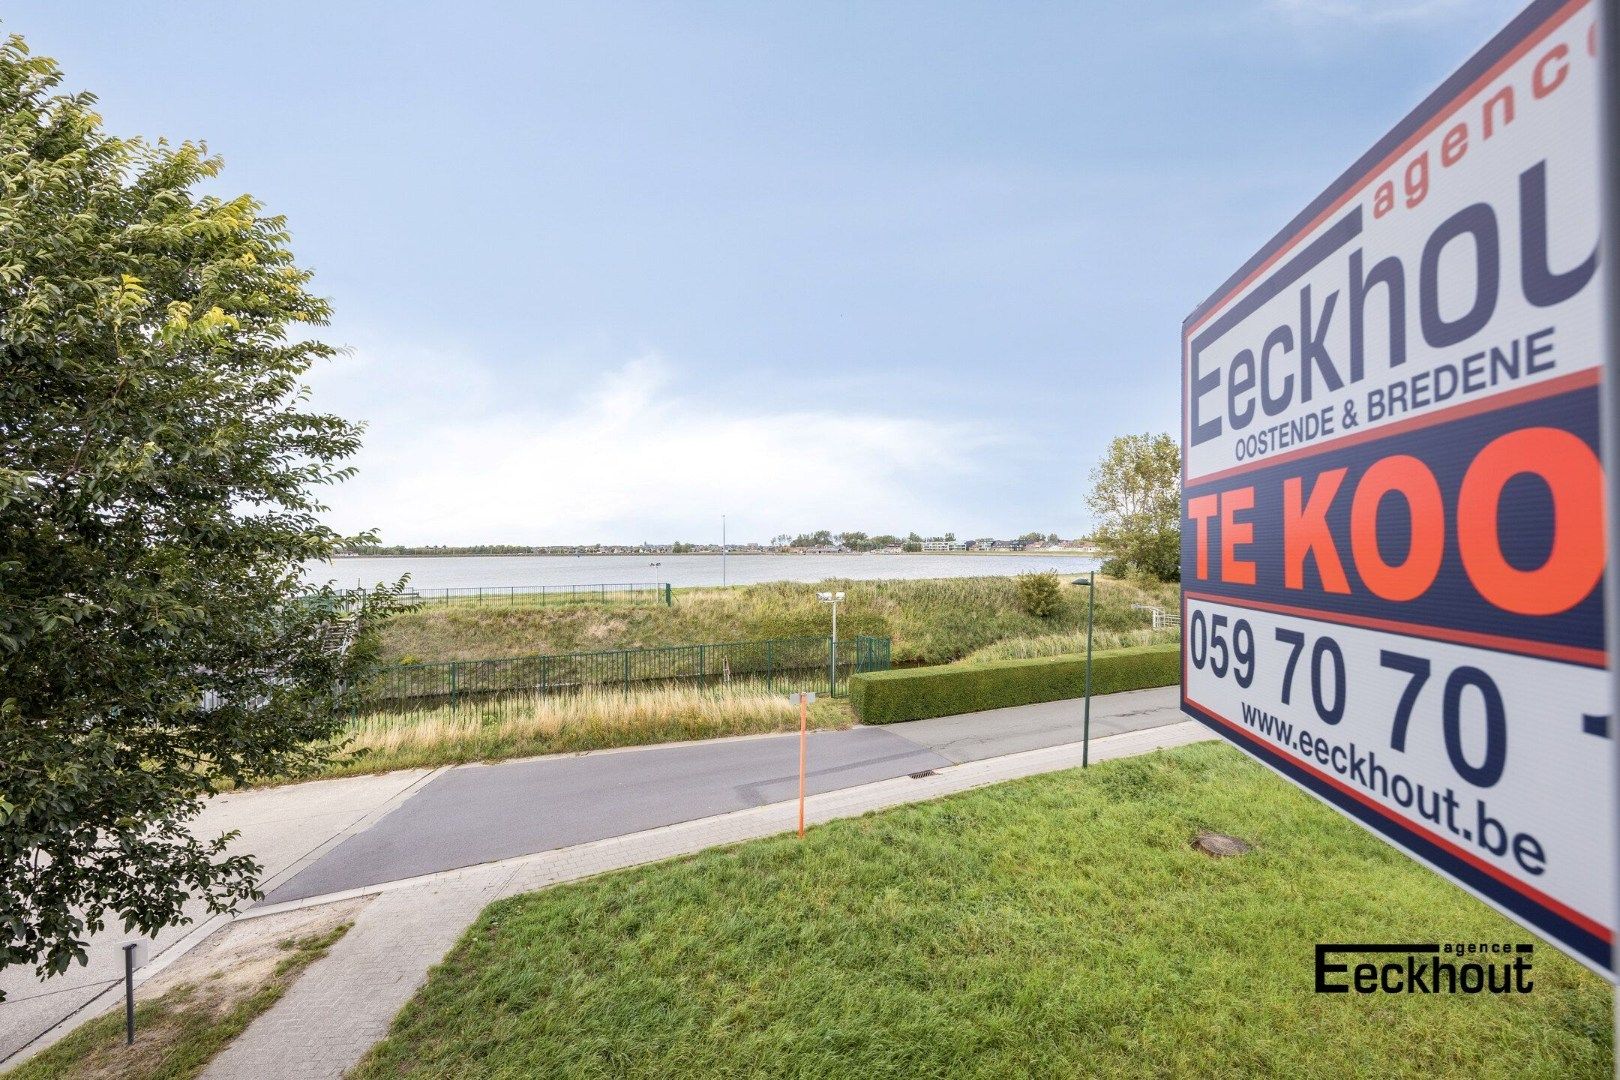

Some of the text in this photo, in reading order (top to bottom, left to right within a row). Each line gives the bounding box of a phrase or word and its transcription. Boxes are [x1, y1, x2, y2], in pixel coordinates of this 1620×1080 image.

[1235, 326, 1556, 462] OOSTENDE & BREDENE
[1188, 426, 1609, 617] TE KOO
[1190, 609, 1508, 789] 059 70 70
[1241, 701, 1548, 876] www.eeckhout.be
